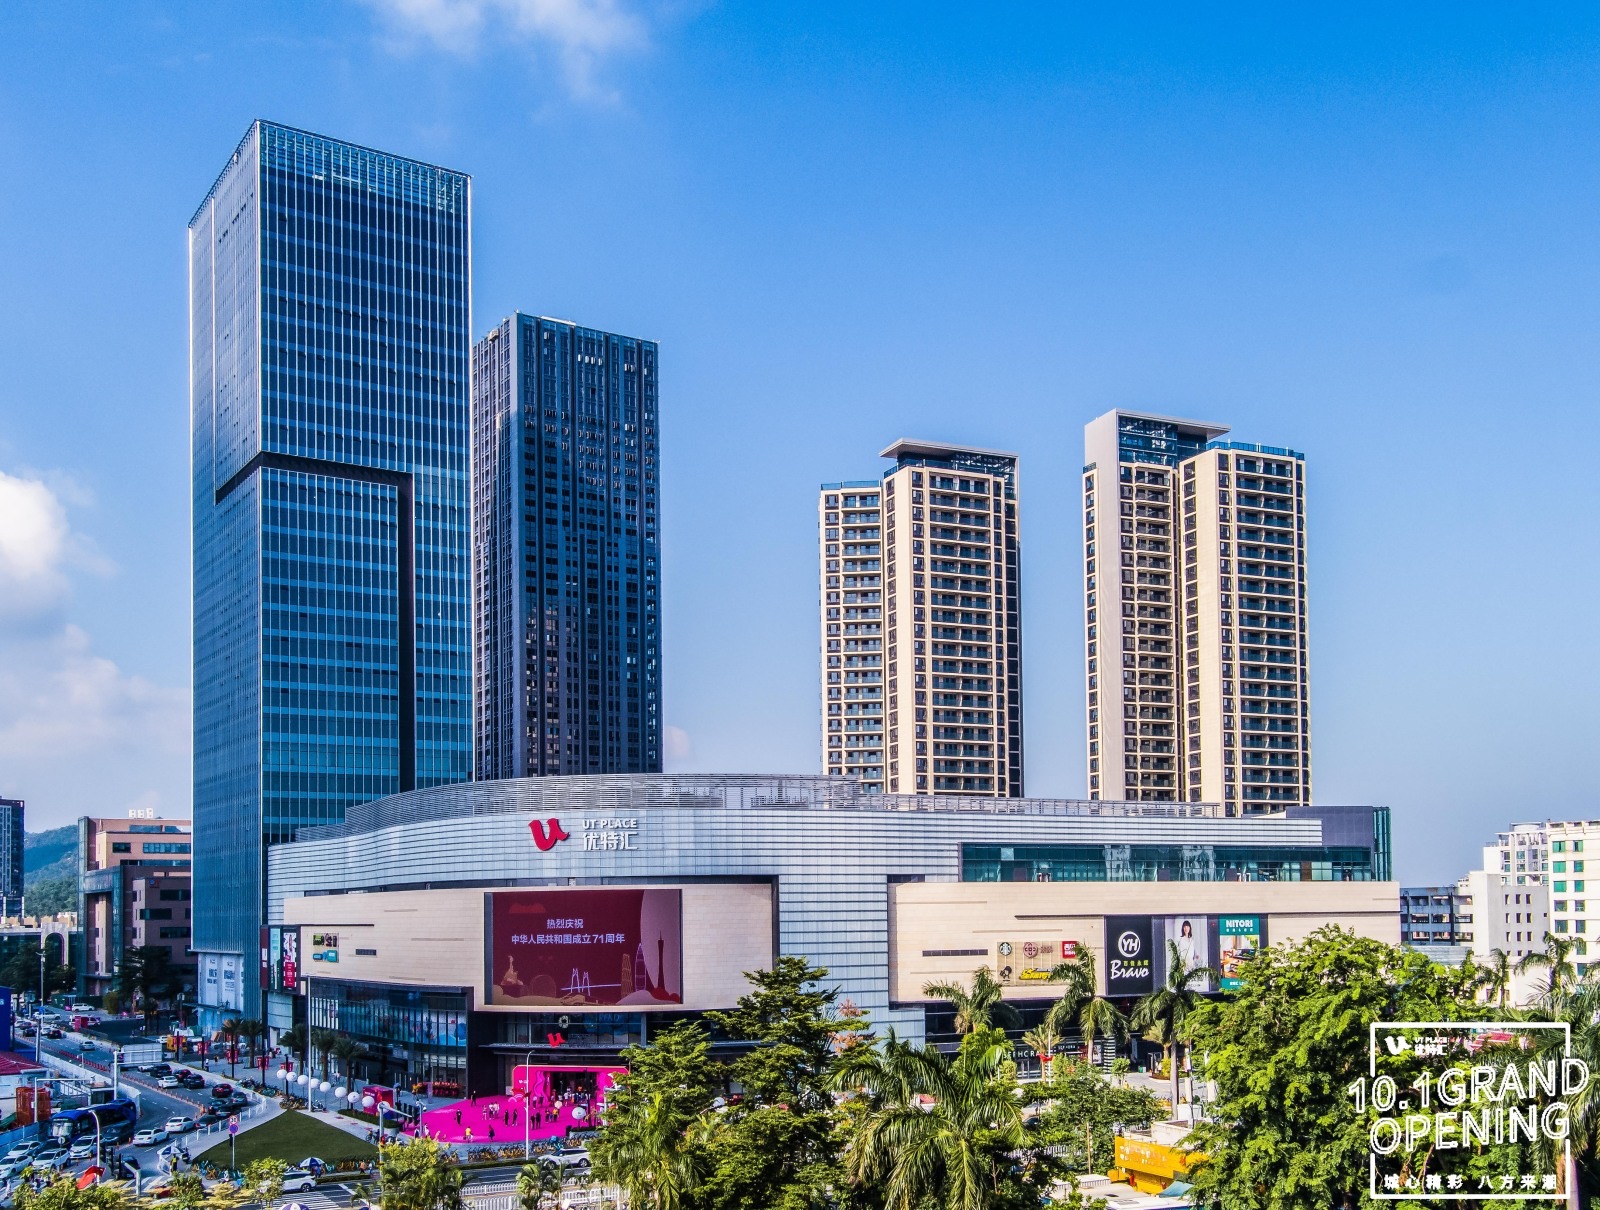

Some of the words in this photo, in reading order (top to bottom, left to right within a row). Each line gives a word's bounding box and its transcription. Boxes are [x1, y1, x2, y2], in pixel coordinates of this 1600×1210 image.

[582, 819, 597, 829] UT
[600, 818, 637, 829] PLACE
[583, 831, 639, 851] 优特汇
[547, 918, 584, 929] 热烈庆祝
[1225, 919, 1254, 928] NITORI
[511, 933, 625, 945] 中华人民共和国成立71周年
[1122, 938, 1138, 951] YH
[1110, 959, 1149, 980] Bravo
